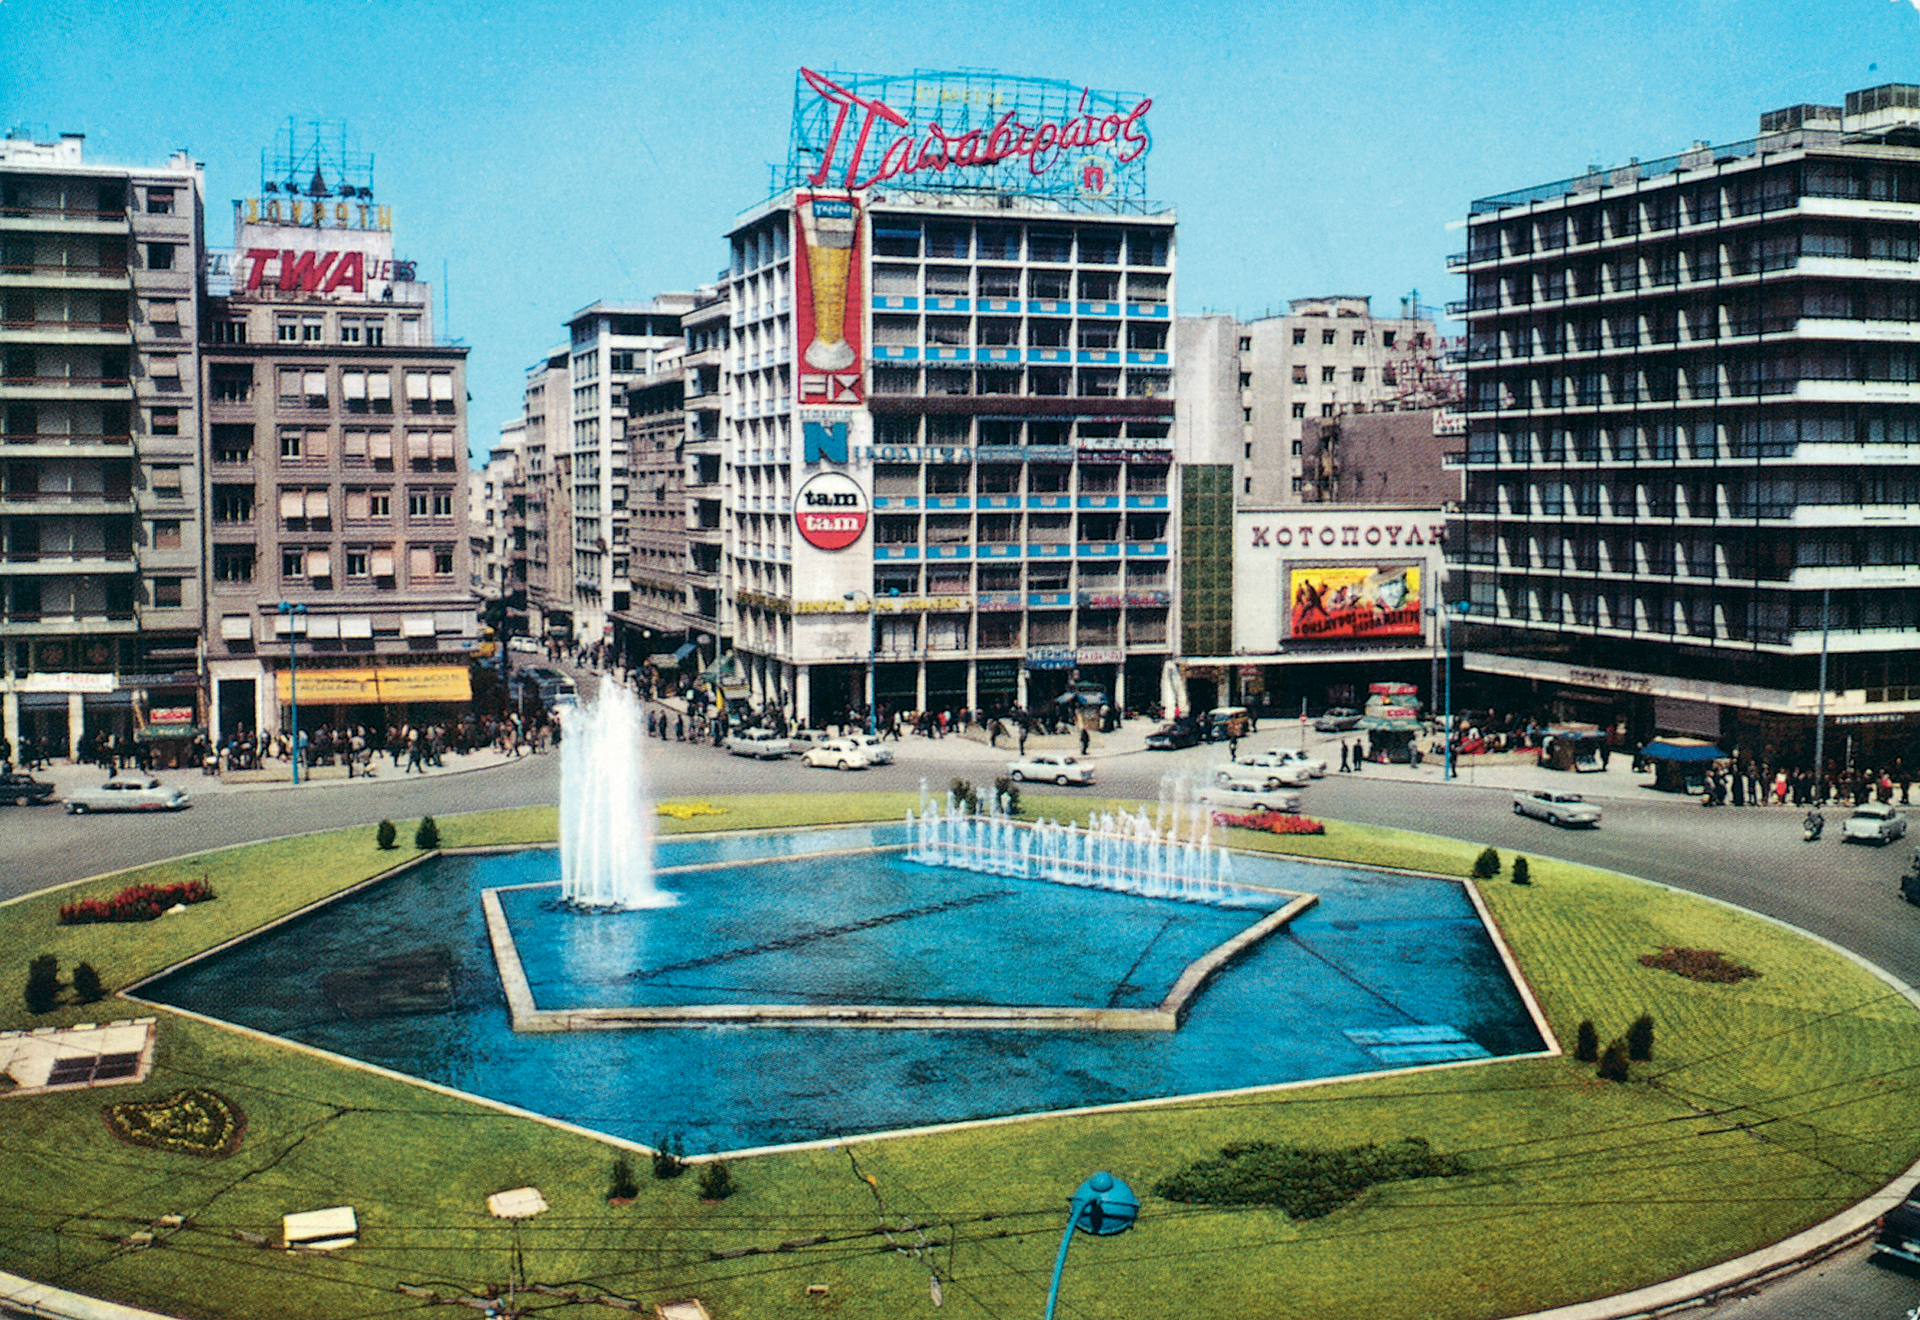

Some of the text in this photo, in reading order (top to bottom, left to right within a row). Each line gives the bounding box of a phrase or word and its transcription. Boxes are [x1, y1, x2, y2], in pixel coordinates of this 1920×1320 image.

[246, 248, 363, 293] TWA
[366, 258, 417, 281] JETS
[800, 374, 861, 402] FIX
[804, 490, 857, 506] tam
[804, 515, 860, 532] tam
[1252, 525, 1447, 547] ΚΟΤΟΠΟΥΛΗ
